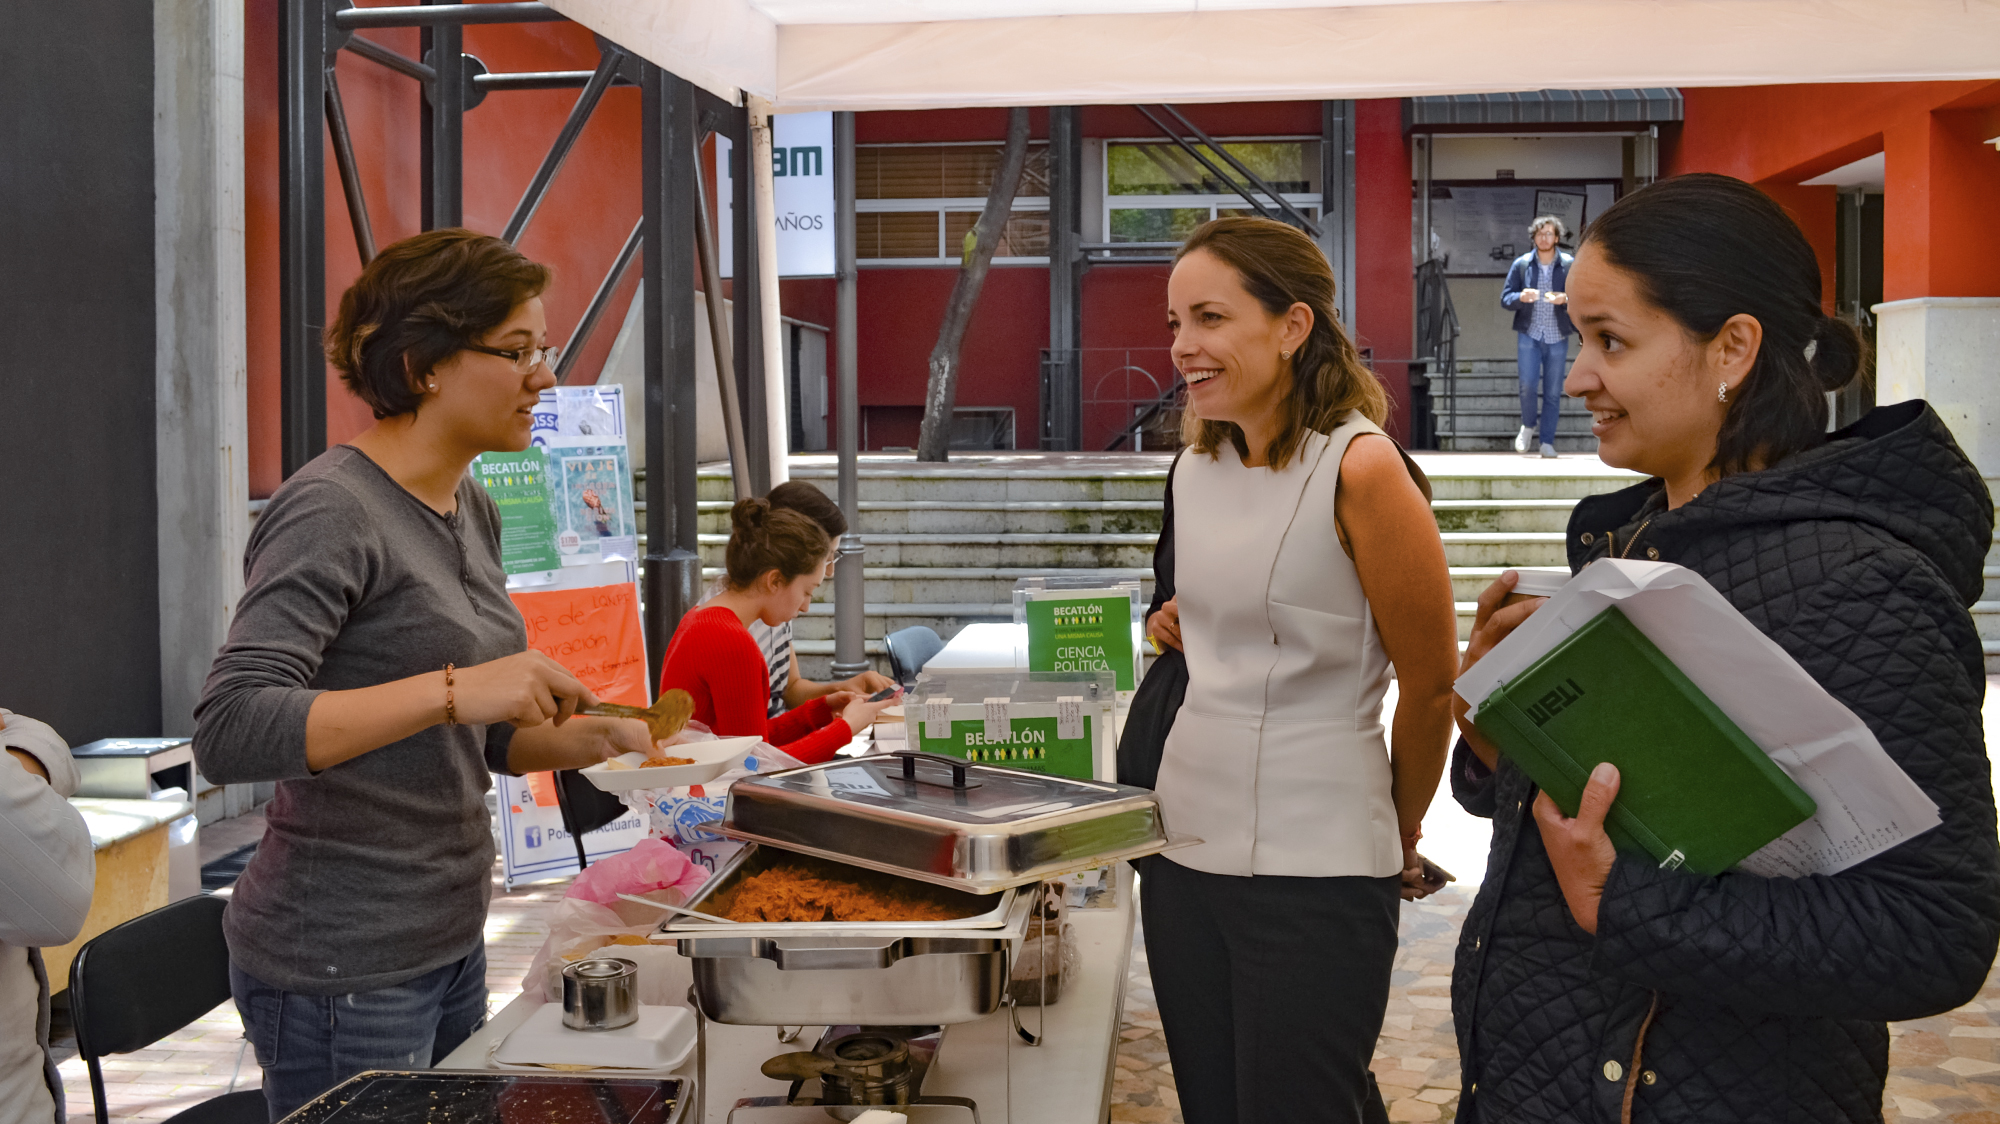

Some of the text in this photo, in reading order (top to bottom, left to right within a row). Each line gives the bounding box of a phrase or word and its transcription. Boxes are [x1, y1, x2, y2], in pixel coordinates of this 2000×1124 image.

[481, 459, 540, 475] BECATLÓN
[567, 460, 614, 472] VIAJE
[558, 602, 585, 626] de
[1053, 604, 1103, 616] BECATLÓN
[1056, 646, 1106, 659] CIENCIA
[1054, 657, 1110, 673] POLÍTICA
[965, 727, 1045, 746] BELÓN
